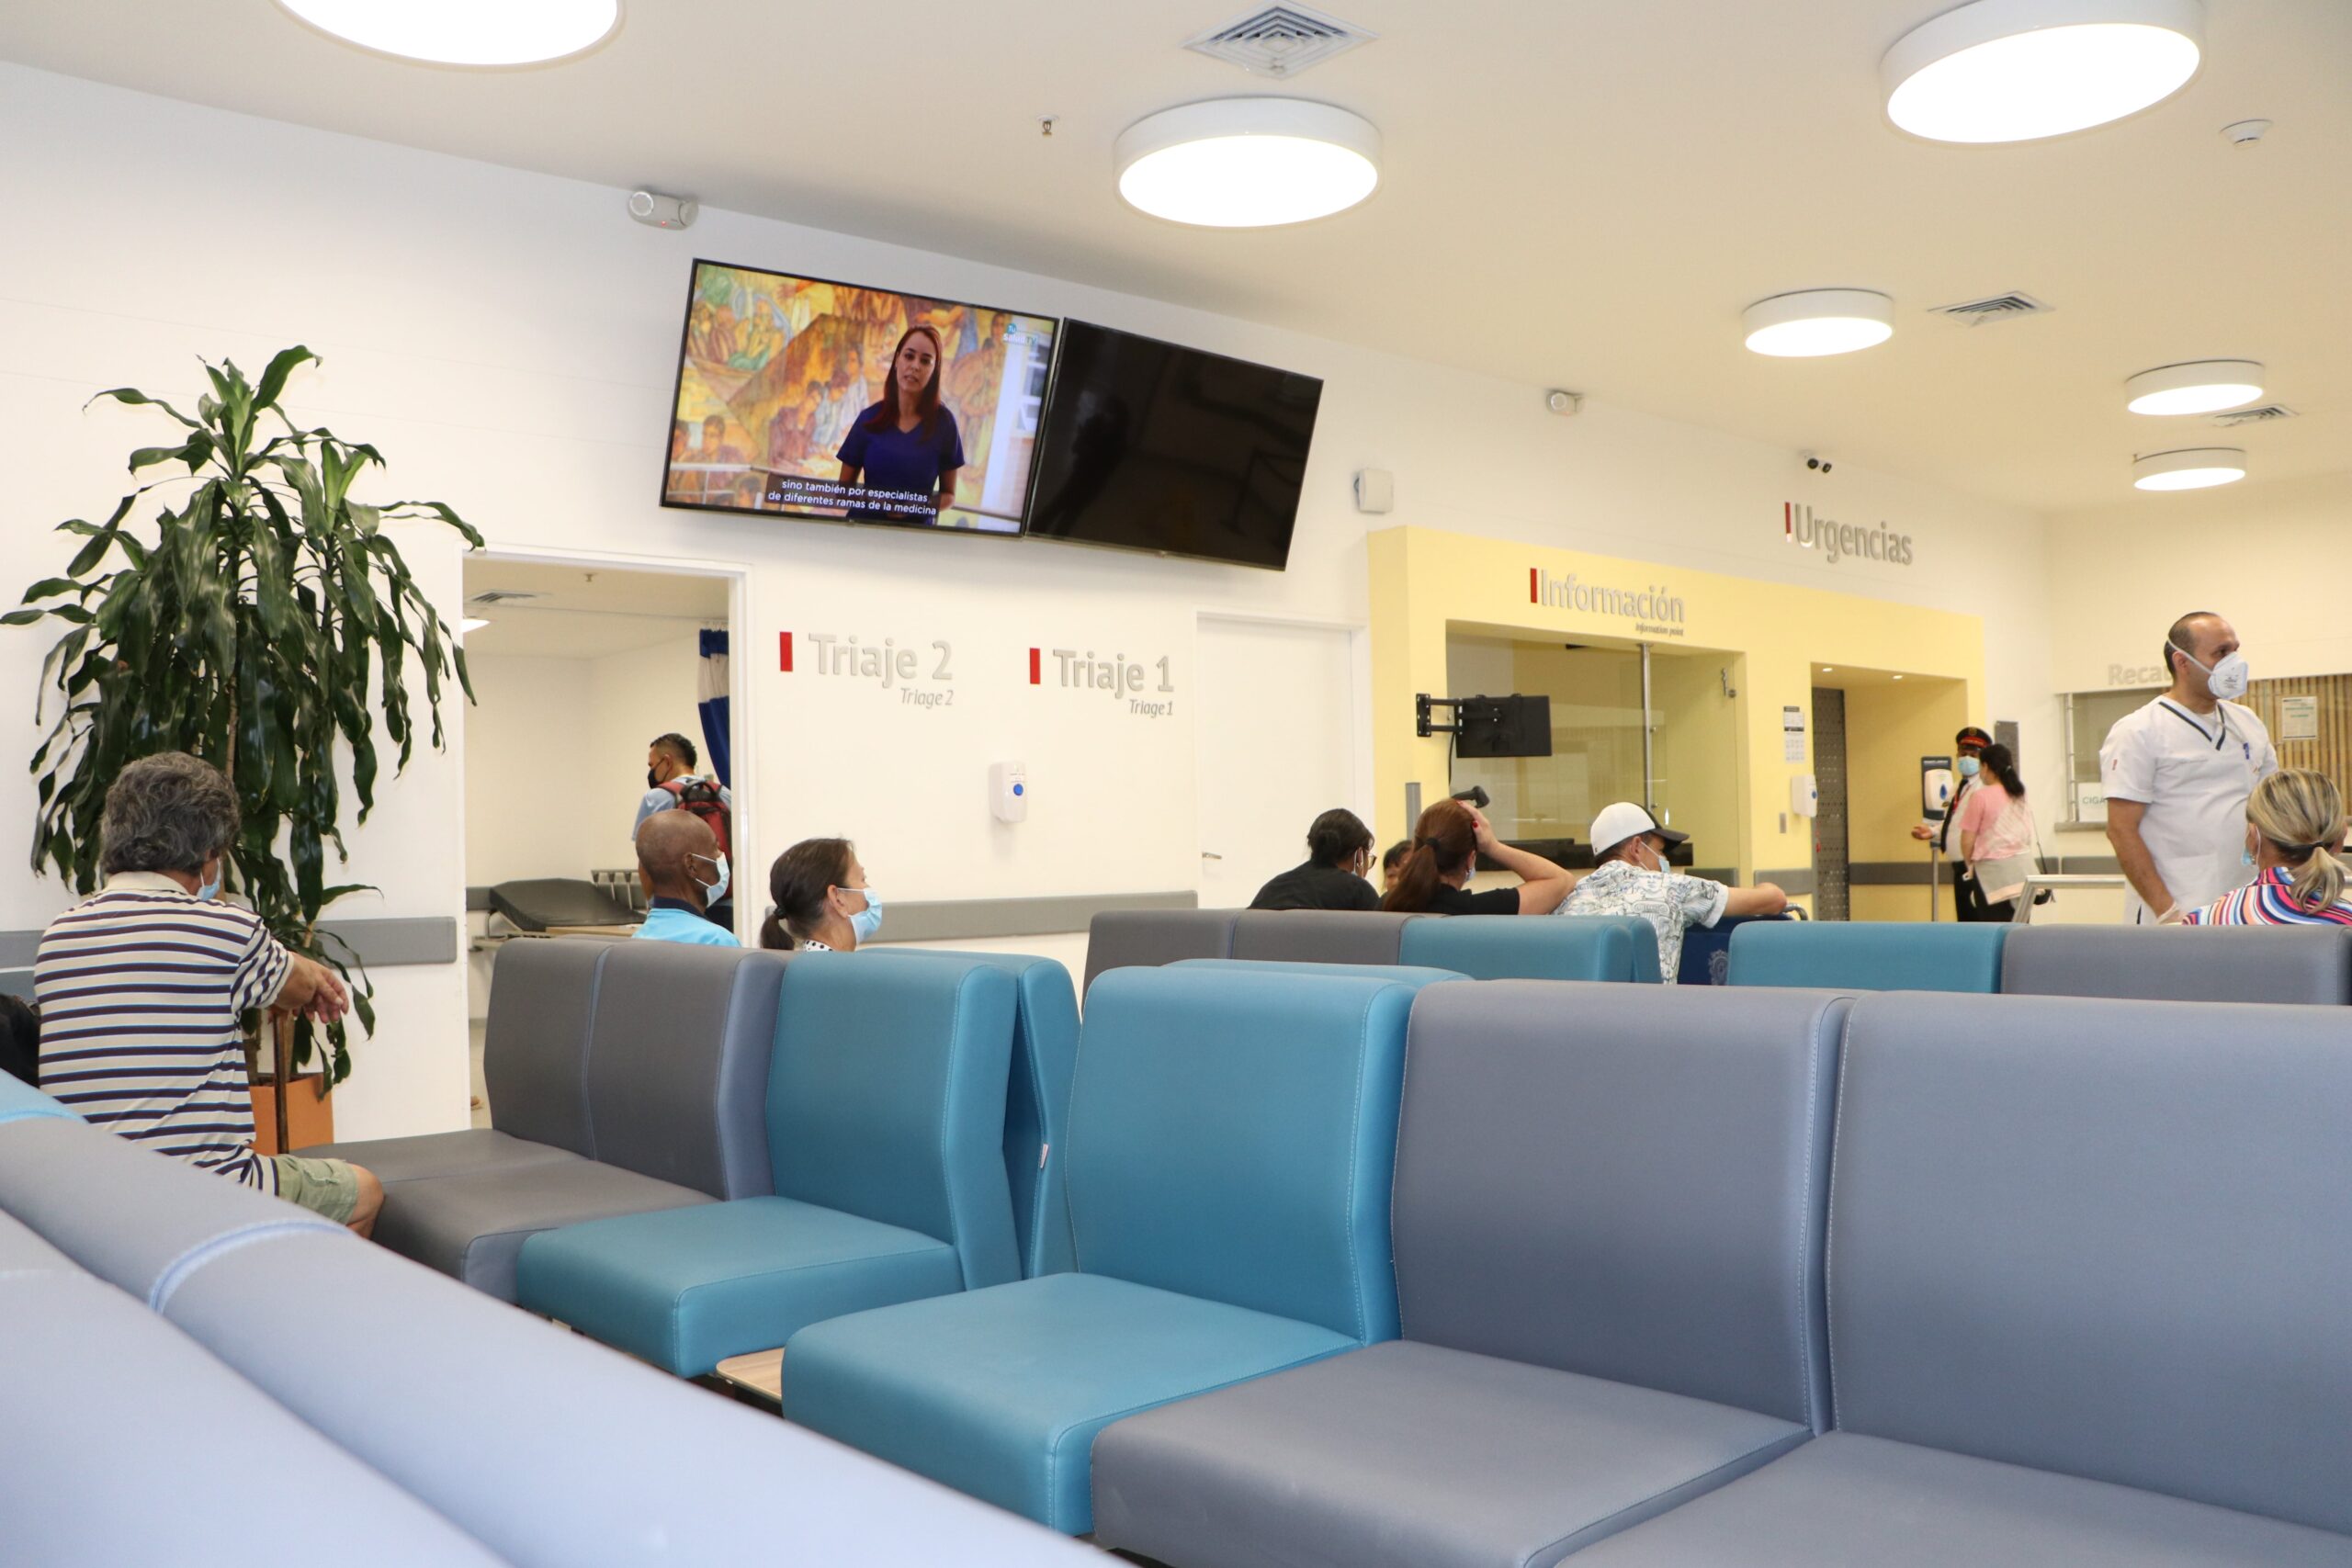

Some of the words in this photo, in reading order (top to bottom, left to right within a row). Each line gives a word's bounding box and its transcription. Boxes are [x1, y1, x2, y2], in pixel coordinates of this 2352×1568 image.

[768, 491, 782, 501] de
[784, 492, 833, 505] diferentes
[836, 499, 865, 509] ramas
[868, 501, 880, 510] de
[883, 502, 891, 511] la
[894, 503, 936, 514] medicina
[782, 479, 803, 490] sino
[806, 482, 845, 494] también
[848, 487, 865, 497] por
[868, 490, 928, 502] especialistas
[1795, 503, 1913, 566] Urgencias
[1541, 570, 1685, 623] Información
[808, 633, 918, 689] Triaje
[932, 640, 953, 681] 2
[1053, 649, 1145, 699] Triaje
[1156, 655, 1174, 693] 1
[900, 687, 944, 709] Triage
[944, 689, 954, 706] 2
[1129, 698, 1165, 718] Triage
[1166, 701, 1173, 716] 1
